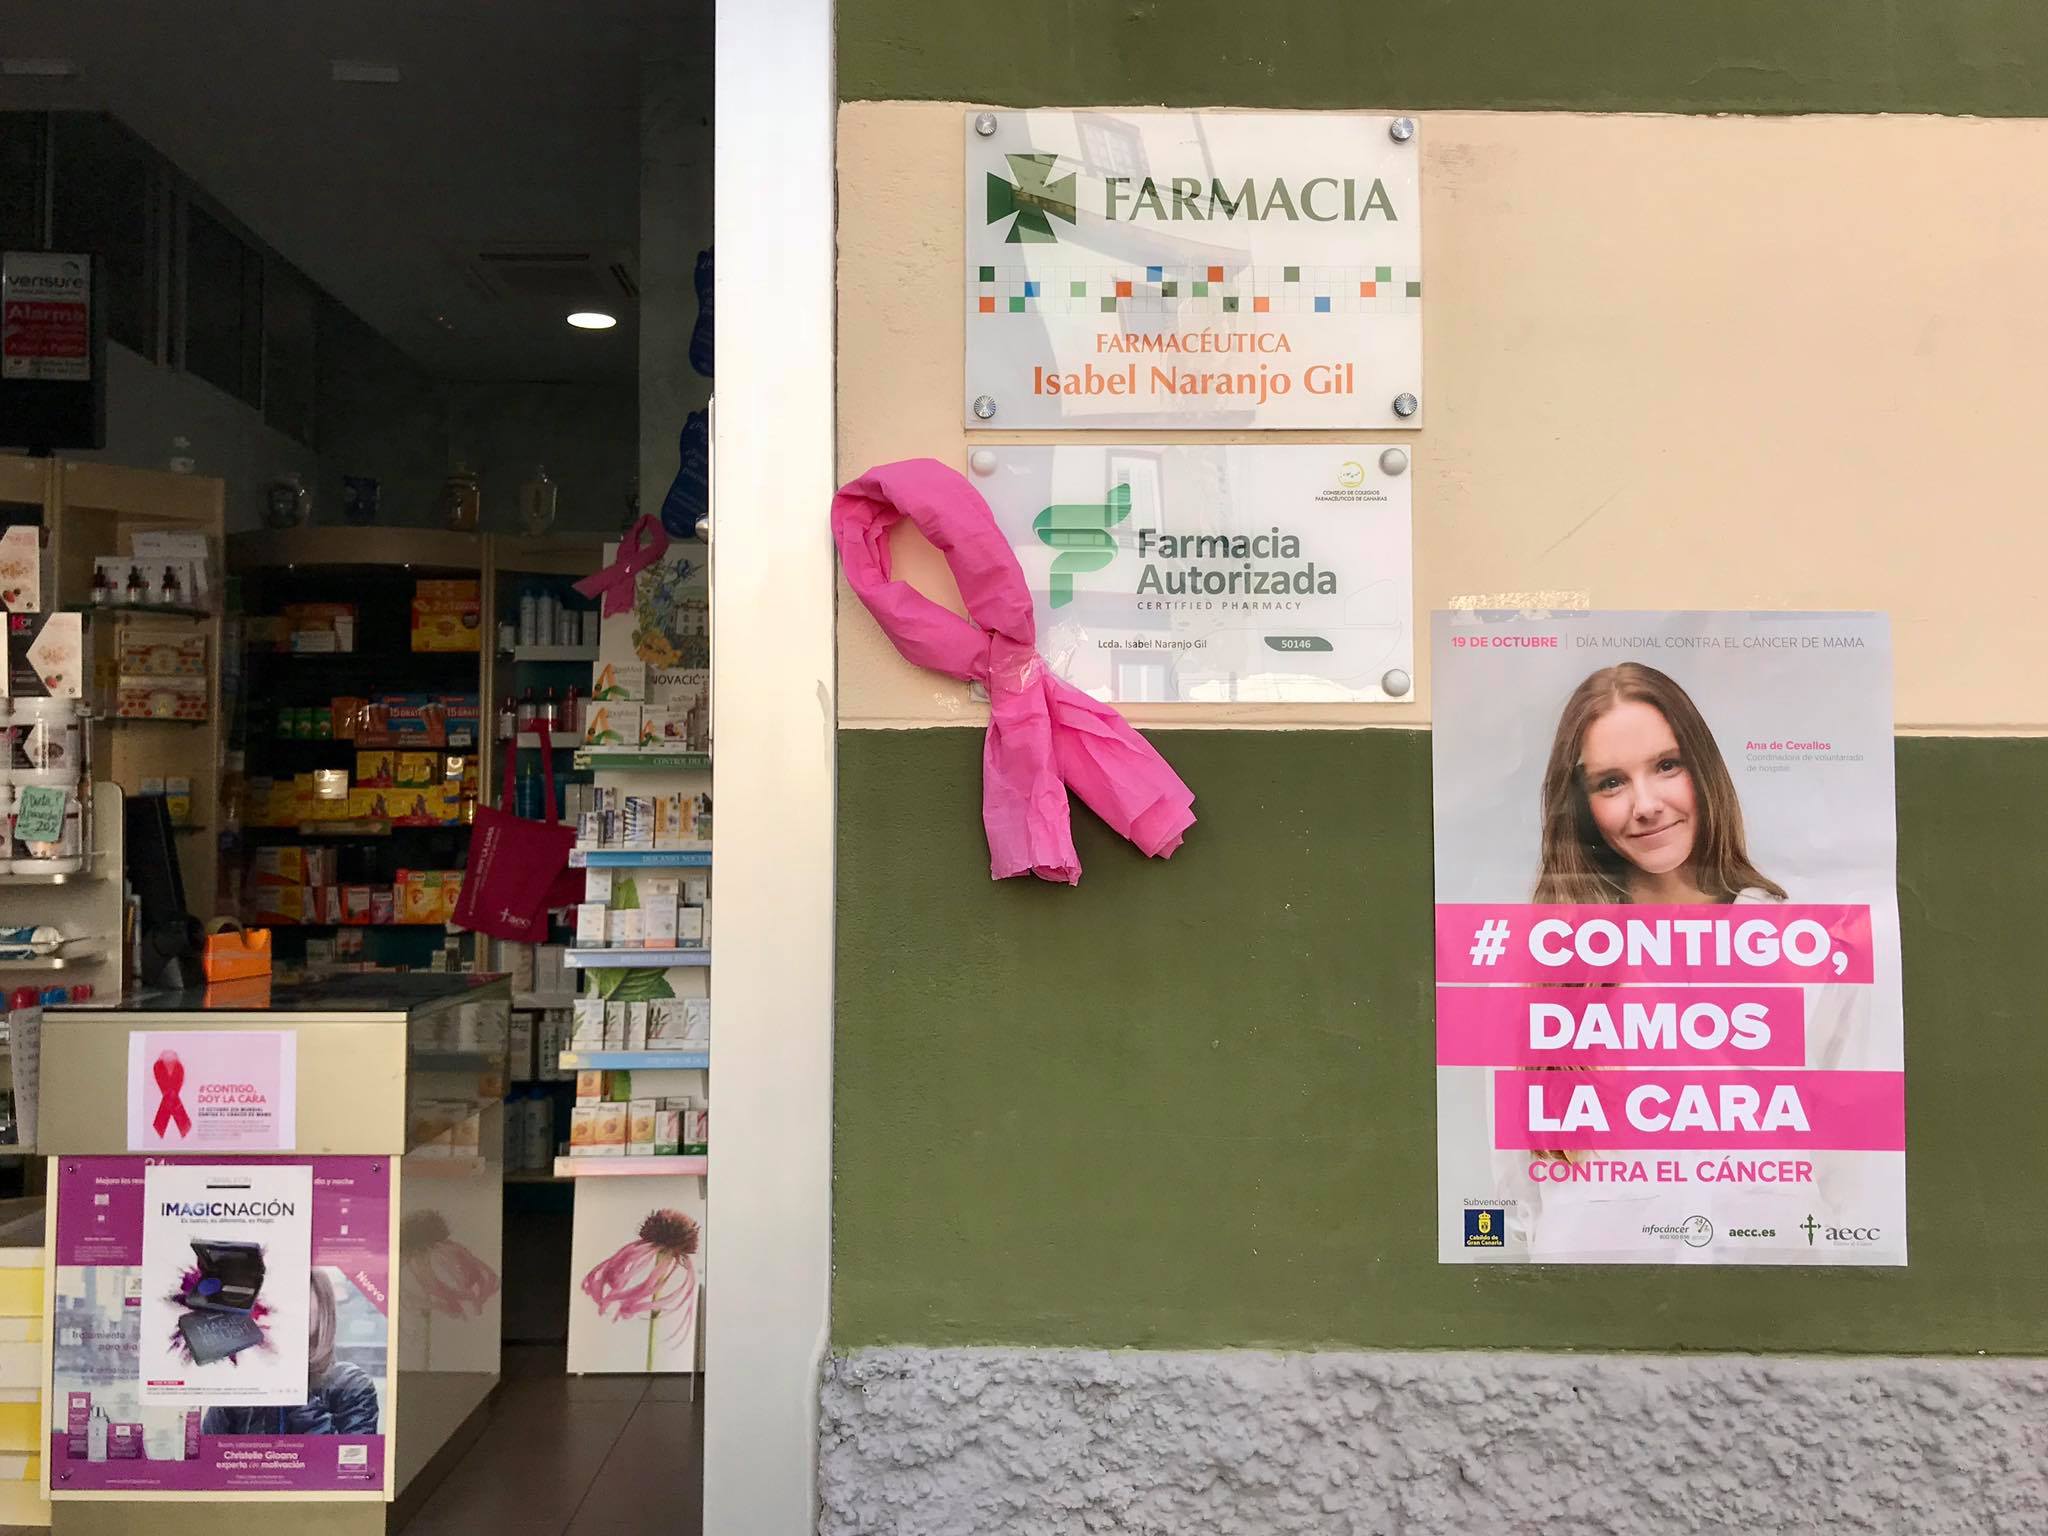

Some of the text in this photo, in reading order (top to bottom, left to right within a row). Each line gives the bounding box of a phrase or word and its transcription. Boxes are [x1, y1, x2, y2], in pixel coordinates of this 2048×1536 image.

[1105, 176, 1397, 221] FARMACIA
[8, 275, 83, 288] verisure
[1096, 327, 1291, 353] FARMACÉUTICA
[1034, 363, 1353, 405] Isabel Naranjo Gil
[1138, 527, 1300, 558] Farmacia
[1136, 562, 1337, 595] Autorizada
[1137, 601, 1303, 611] CERTIFIED PHARMACY
[1098, 639, 1207, 651] Lcda. Isabel Naranjo Gil
[1281, 640, 1312, 650] 50146
[1451, 636, 1466, 648] 19
[1470, 636, 1488, 648] DE
[1491, 636, 1558, 648] OCTUBRE
[1576, 633, 1599, 649] DÍA
[1602, 637, 1661, 649] MUNDIAL
[1665, 637, 1721, 649] CONTRA
[1724, 637, 1739, 649] EL
[1801, 637, 1819, 649] DE
[1823, 637, 1865, 649] MAMA
[1746, 741, 1831, 750] Ana de Cevallos
[1469, 919, 1849, 975] # CONTIGO,
[1529, 1002, 1771, 1050] DAMOS
[198, 1094, 266, 1103] DOY LA CARA
[1528, 1085, 1811, 1132] LA CARA
[1528, 1156, 1813, 1183] CONTRA EL CÁNCER
[161, 1199, 295, 1216] IMAGICNACIÓN
[1464, 1198, 1518, 1206] Subvenciona:
[1642, 1224, 1690, 1236] infocáncer
[1729, 1228, 1777, 1238] aecc.es
[1825, 1227, 1881, 1241] aecc
[356, 1271, 385, 1302] Nuevo
